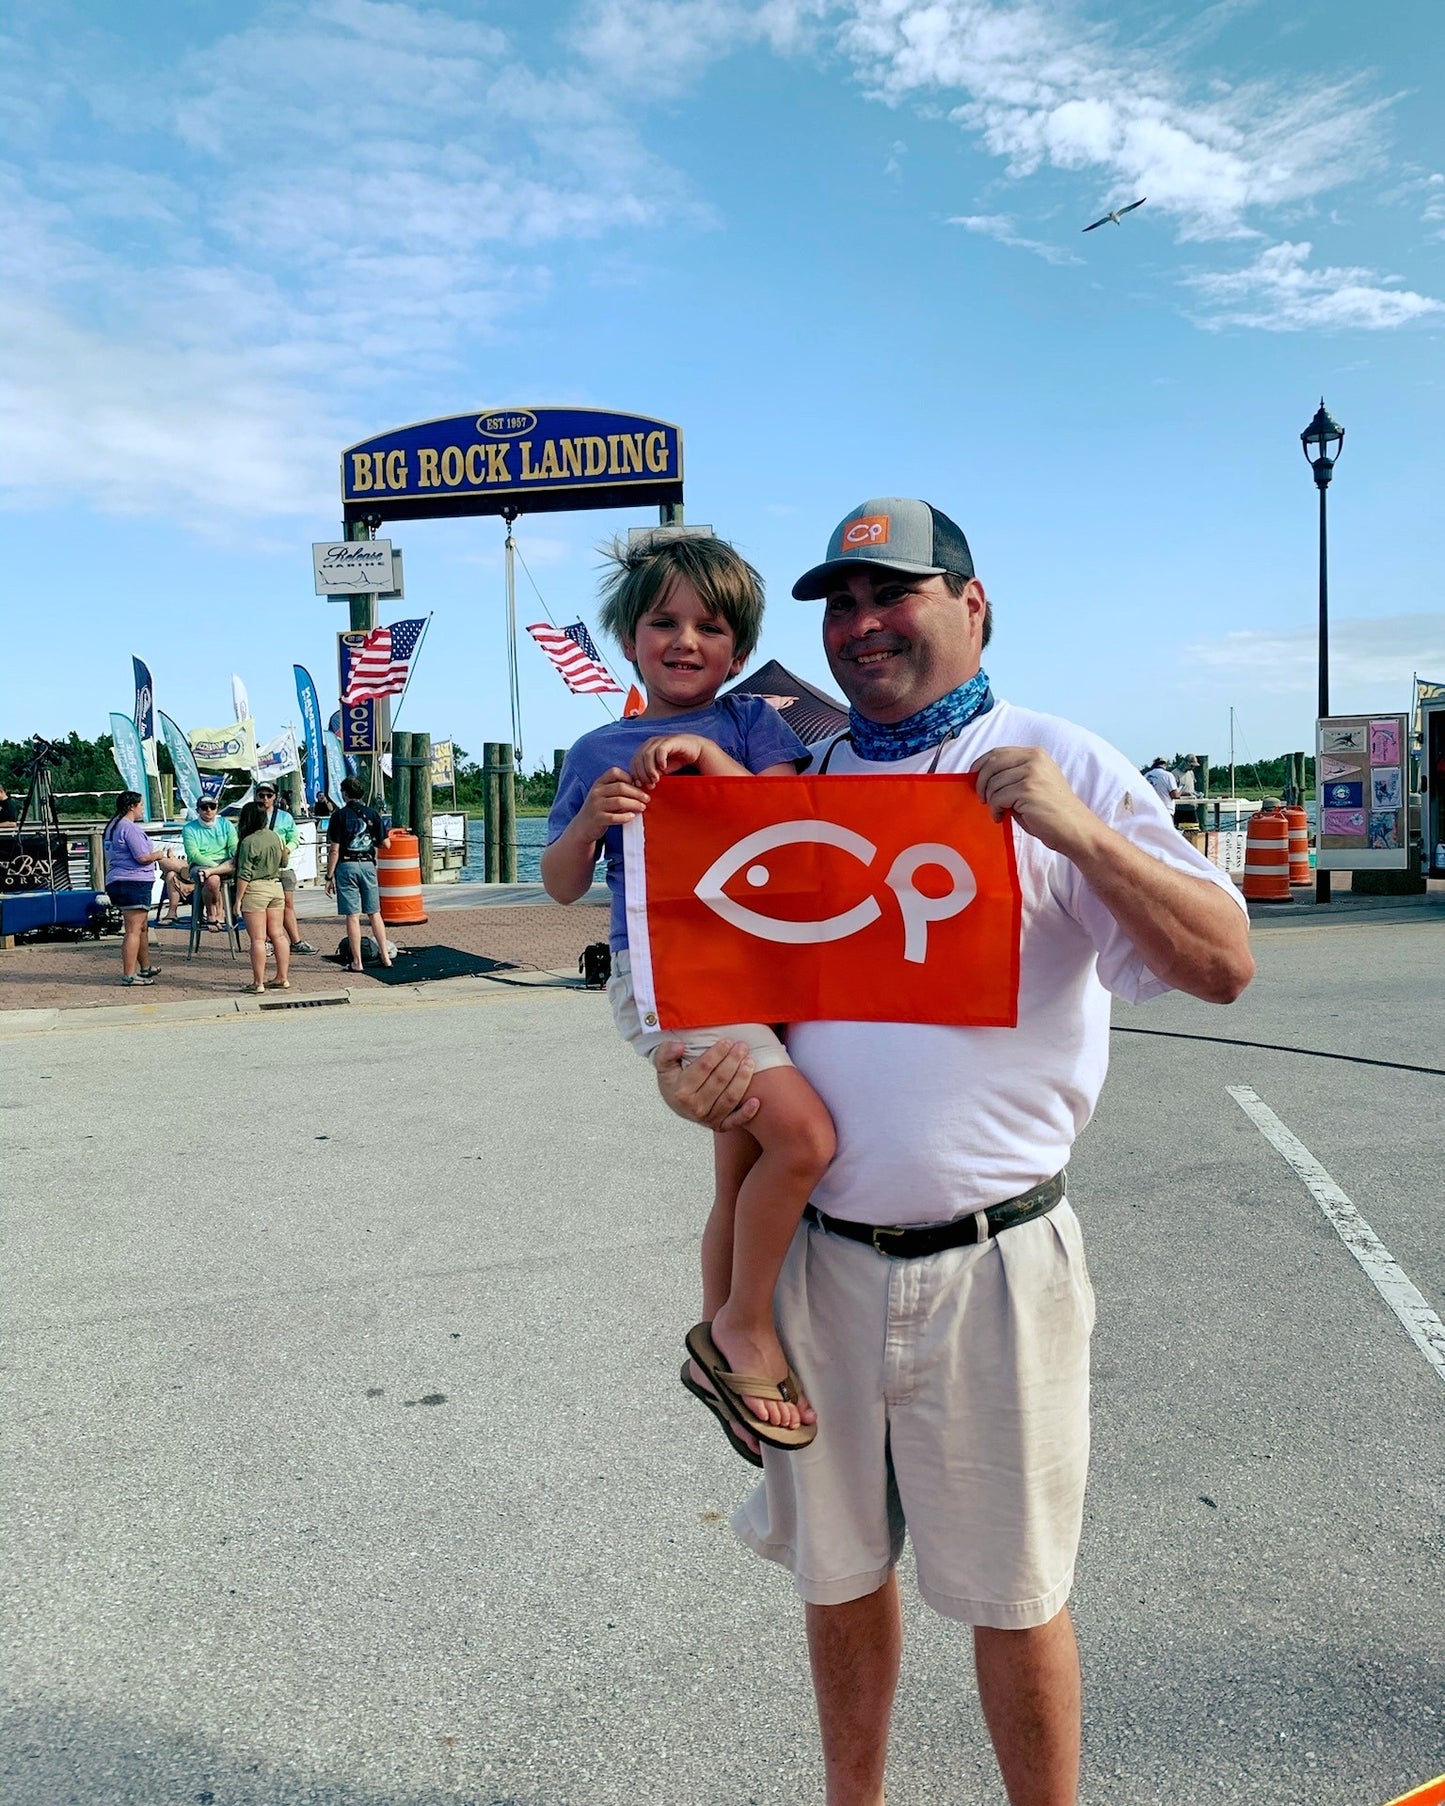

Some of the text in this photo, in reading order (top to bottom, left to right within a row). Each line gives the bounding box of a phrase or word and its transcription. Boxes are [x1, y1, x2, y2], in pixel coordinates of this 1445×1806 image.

[486, 417, 527, 431] EST 1957
[352, 430, 669, 492] BIG ROCK LANDING
[323, 546, 384, 564] Release
[349, 699, 371, 748] OCK
